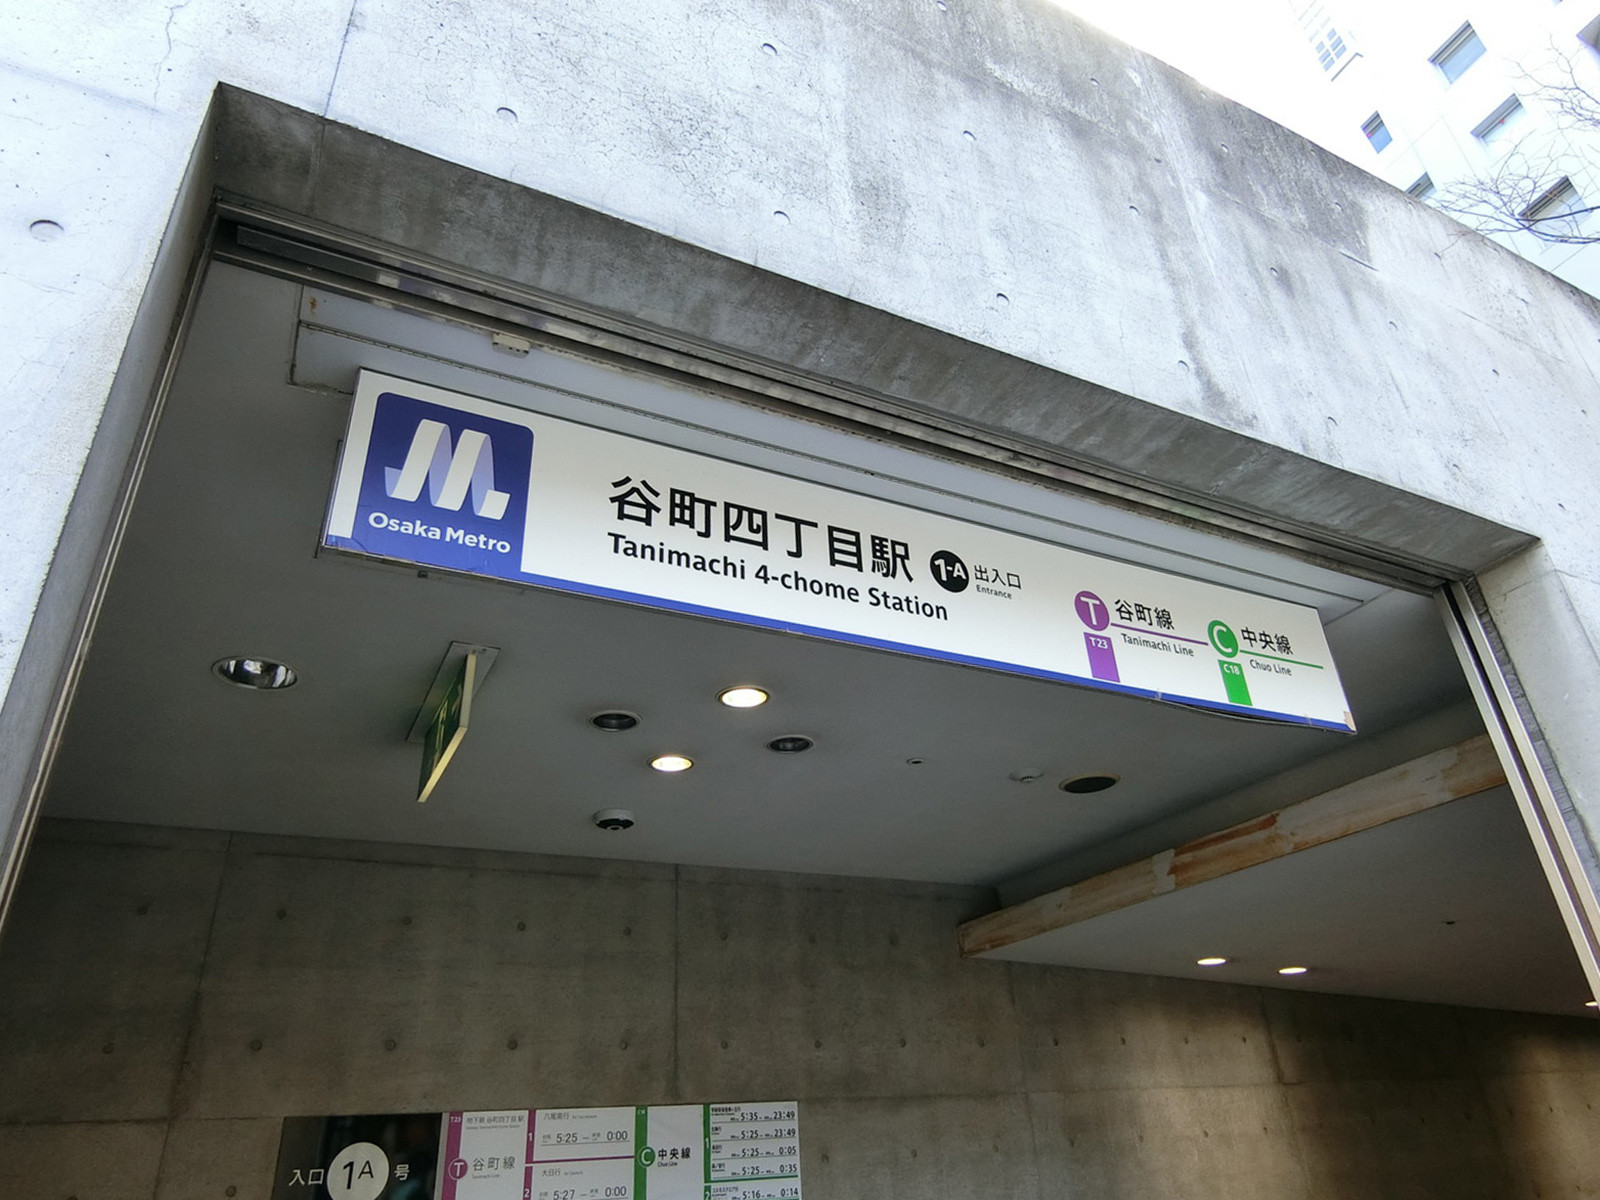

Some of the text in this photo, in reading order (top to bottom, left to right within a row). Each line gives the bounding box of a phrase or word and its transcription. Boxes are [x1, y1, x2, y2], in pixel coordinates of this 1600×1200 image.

[368, 511, 511, 553] Osaka Metro
[608, 475, 914, 583] 谷町四丁目駅
[607, 531, 949, 621] Tanimachi 4-chome Station
[933, 558, 967, 582] 1-A
[973, 564, 1022, 590] 出入口
[976, 584, 1013, 600] Entrance
[1079, 596, 1101, 626] T
[1114, 598, 1175, 630] 谷町線
[1088, 636, 1109, 650] T23
[1120, 632, 1195, 657] Tanimachi Line
[1212, 624, 1233, 653] C
[1240, 626, 1294, 656] 中央線
[1249, 658, 1293, 677] Chuo Line
[740, 1111, 758, 1121] 5:35
[773, 1110, 796, 1120] 23:49
[528, 1132, 534, 1142] 1
[556, 1132, 578, 1144] 5:25
[606, 1130, 629, 1141] 0:00
[741, 1129, 759, 1139] 5:25
[774, 1128, 796, 1139] 23:49
[657, 1146, 692, 1160] 中央線
[741, 1147, 760, 1157] 5:25
[779, 1146, 797, 1156] 0:05
[472, 1155, 516, 1172] 谷町線
[741, 1165, 760, 1176] 5:25
[779, 1163, 798, 1174] 0:35
[288, 1168, 325, 1187] 入口
[393, 1163, 411, 1182] 号
[524, 1188, 530, 1198] 2
[553, 1189, 576, 1200] 5:27
[604, 1185, 627, 1198] 0:00
[742, 1189, 761, 1200] 5:16
[780, 1187, 799, 1198] 0:14
